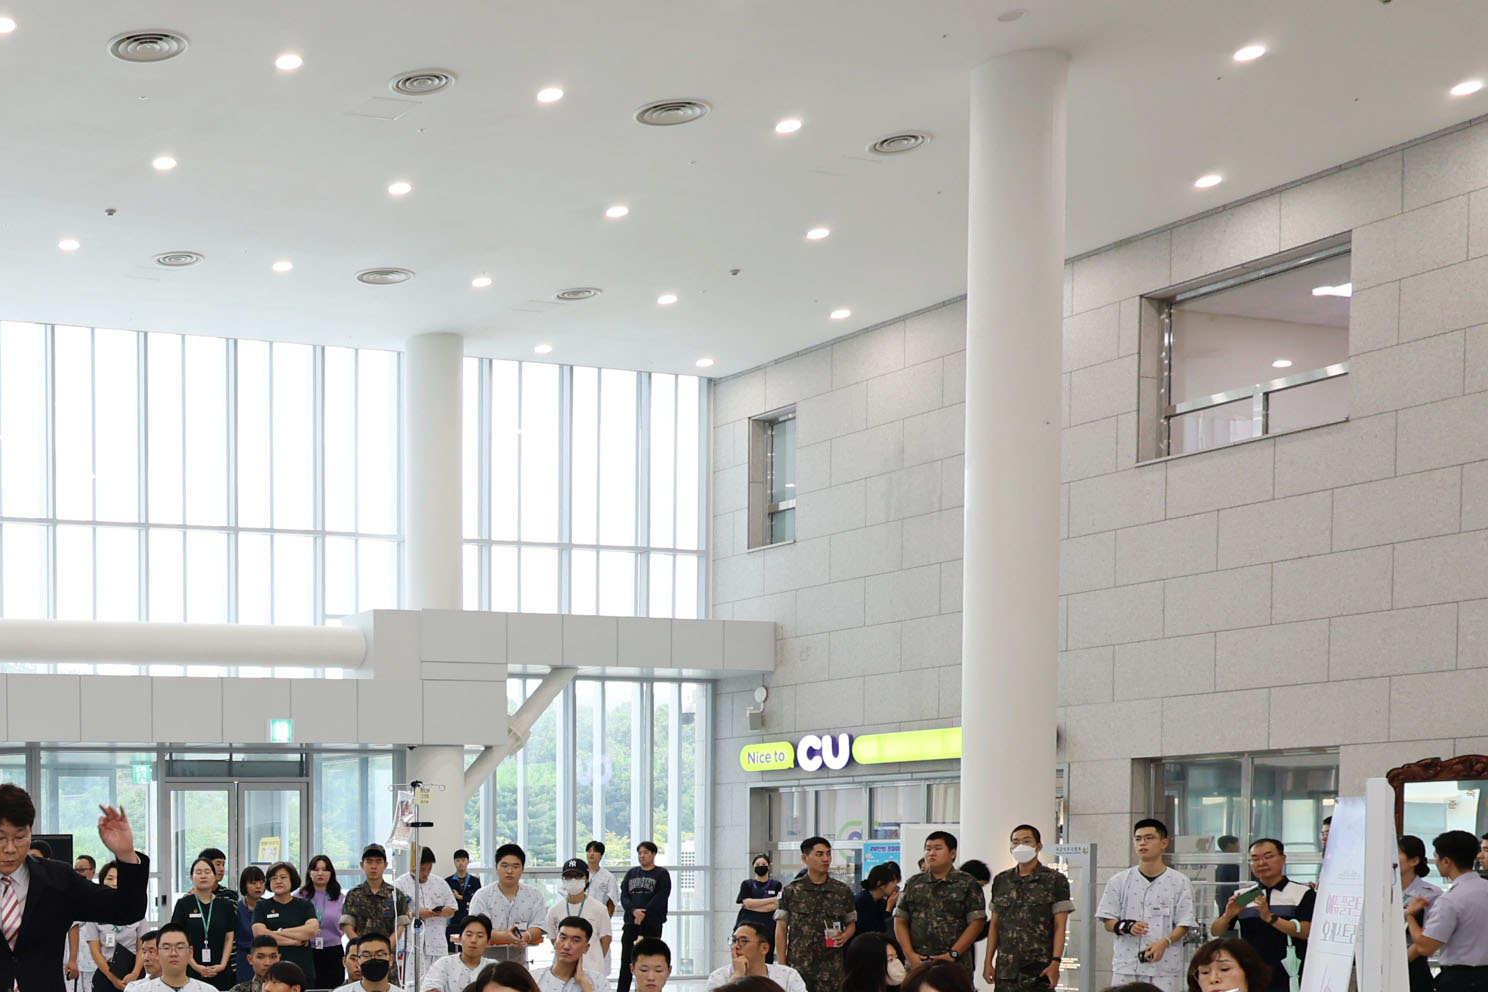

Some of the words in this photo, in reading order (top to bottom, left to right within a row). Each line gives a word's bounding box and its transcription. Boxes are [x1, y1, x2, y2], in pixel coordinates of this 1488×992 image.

[747, 750, 771, 765] Nice
[774, 750, 785, 763] to
[796, 732, 852, 773] CU
